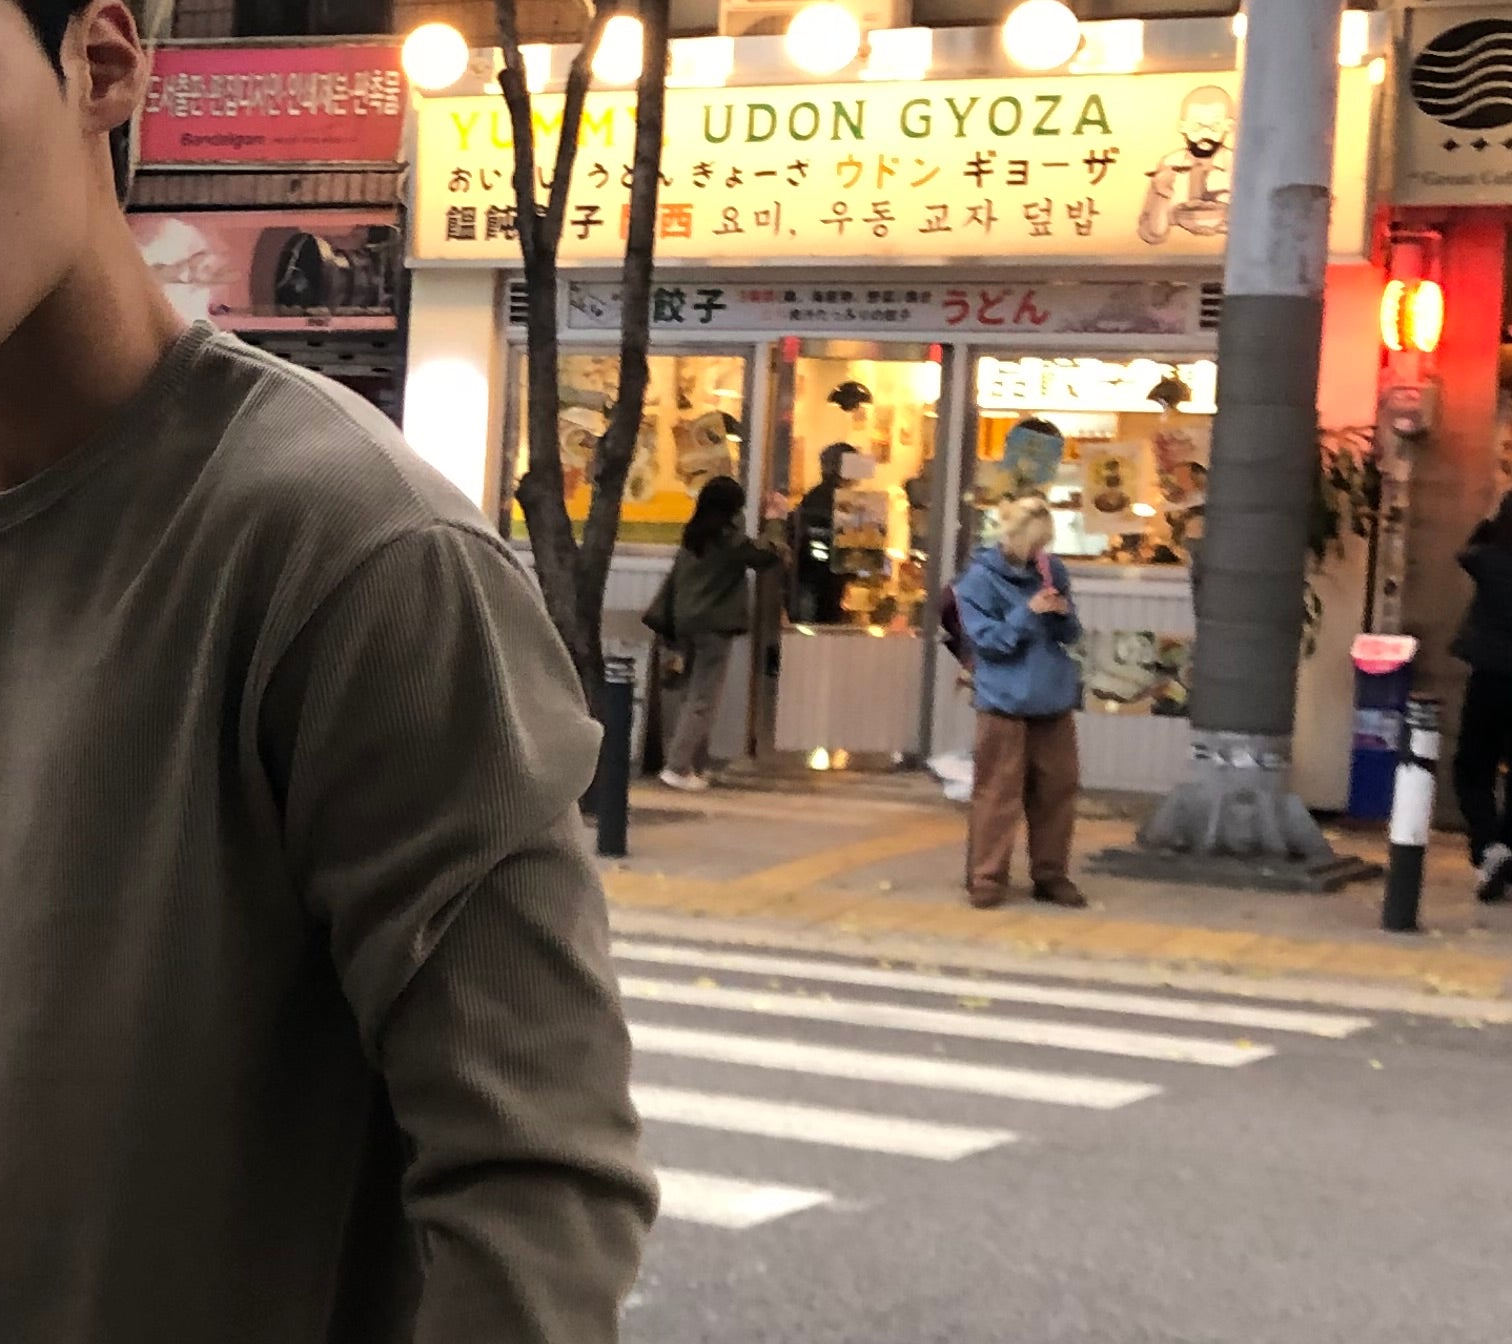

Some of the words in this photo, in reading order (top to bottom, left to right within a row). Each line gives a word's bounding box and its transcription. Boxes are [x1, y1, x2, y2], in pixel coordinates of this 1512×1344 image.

[703, 99, 867, 144] UDON
[899, 93, 1113, 139] GYOZA
[836, 154, 941, 189] ウドン
[963, 147, 1121, 187] ギョーザ
[820, 200, 896, 239] 우동
[918, 197, 999, 234] 교자
[1023, 196, 1101, 237] 덮밥
[940, 288, 1050, 327] うどん
